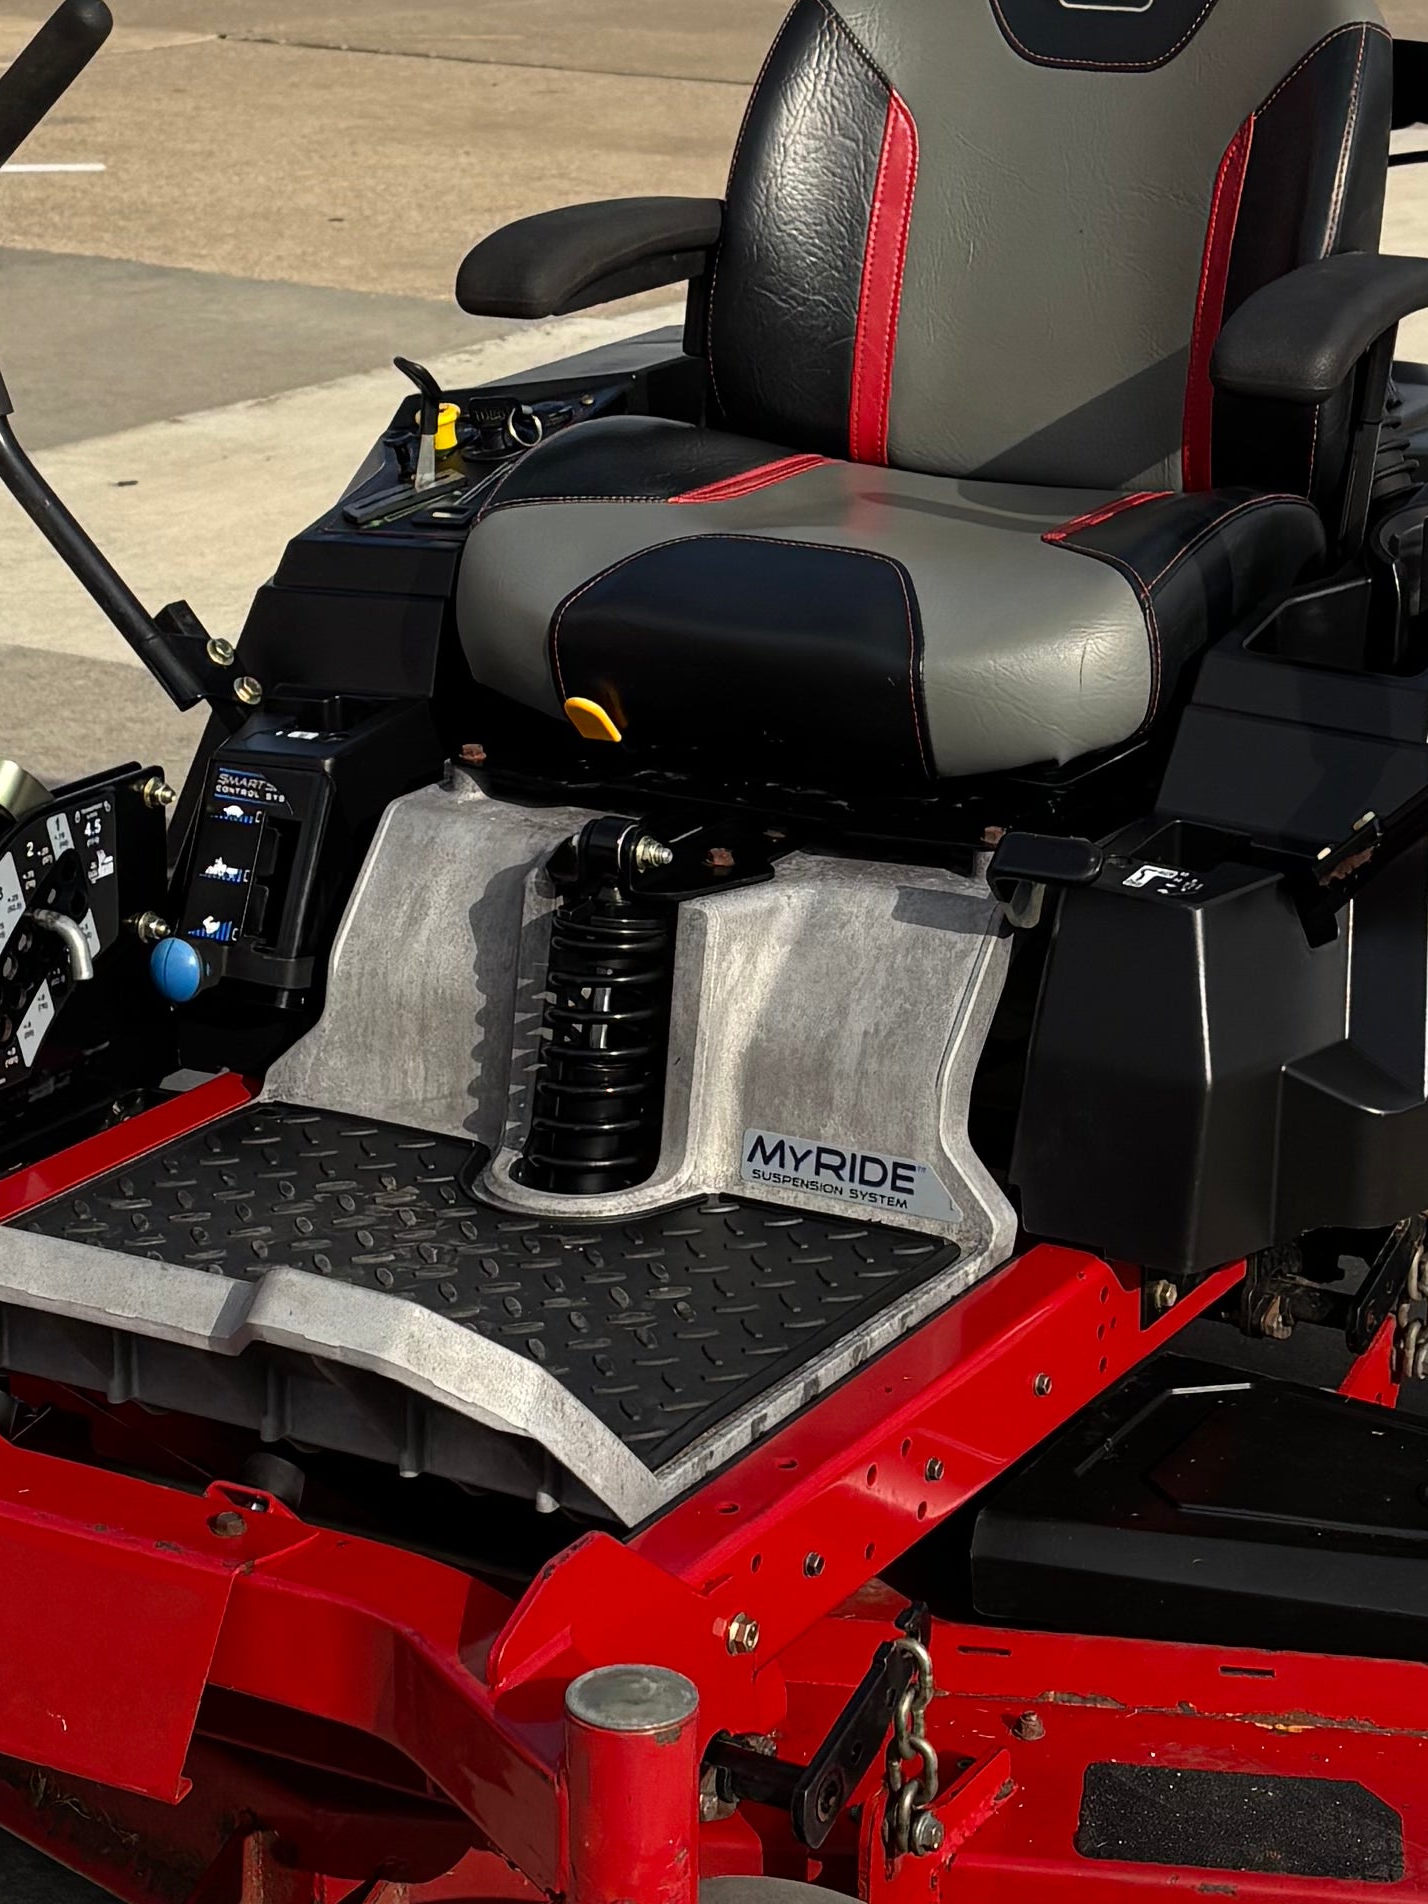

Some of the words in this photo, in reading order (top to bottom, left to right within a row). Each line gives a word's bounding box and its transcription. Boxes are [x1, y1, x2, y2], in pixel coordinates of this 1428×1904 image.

[215, 784, 260, 799] CONTROL
[55, 816, 60, 832] 1
[84, 817, 102, 837] 4.5
[26, 841, 34, 858] 2
[751, 1168, 843, 1196] SUSPENSION
[849, 1188, 908, 1209] SYSTEM
